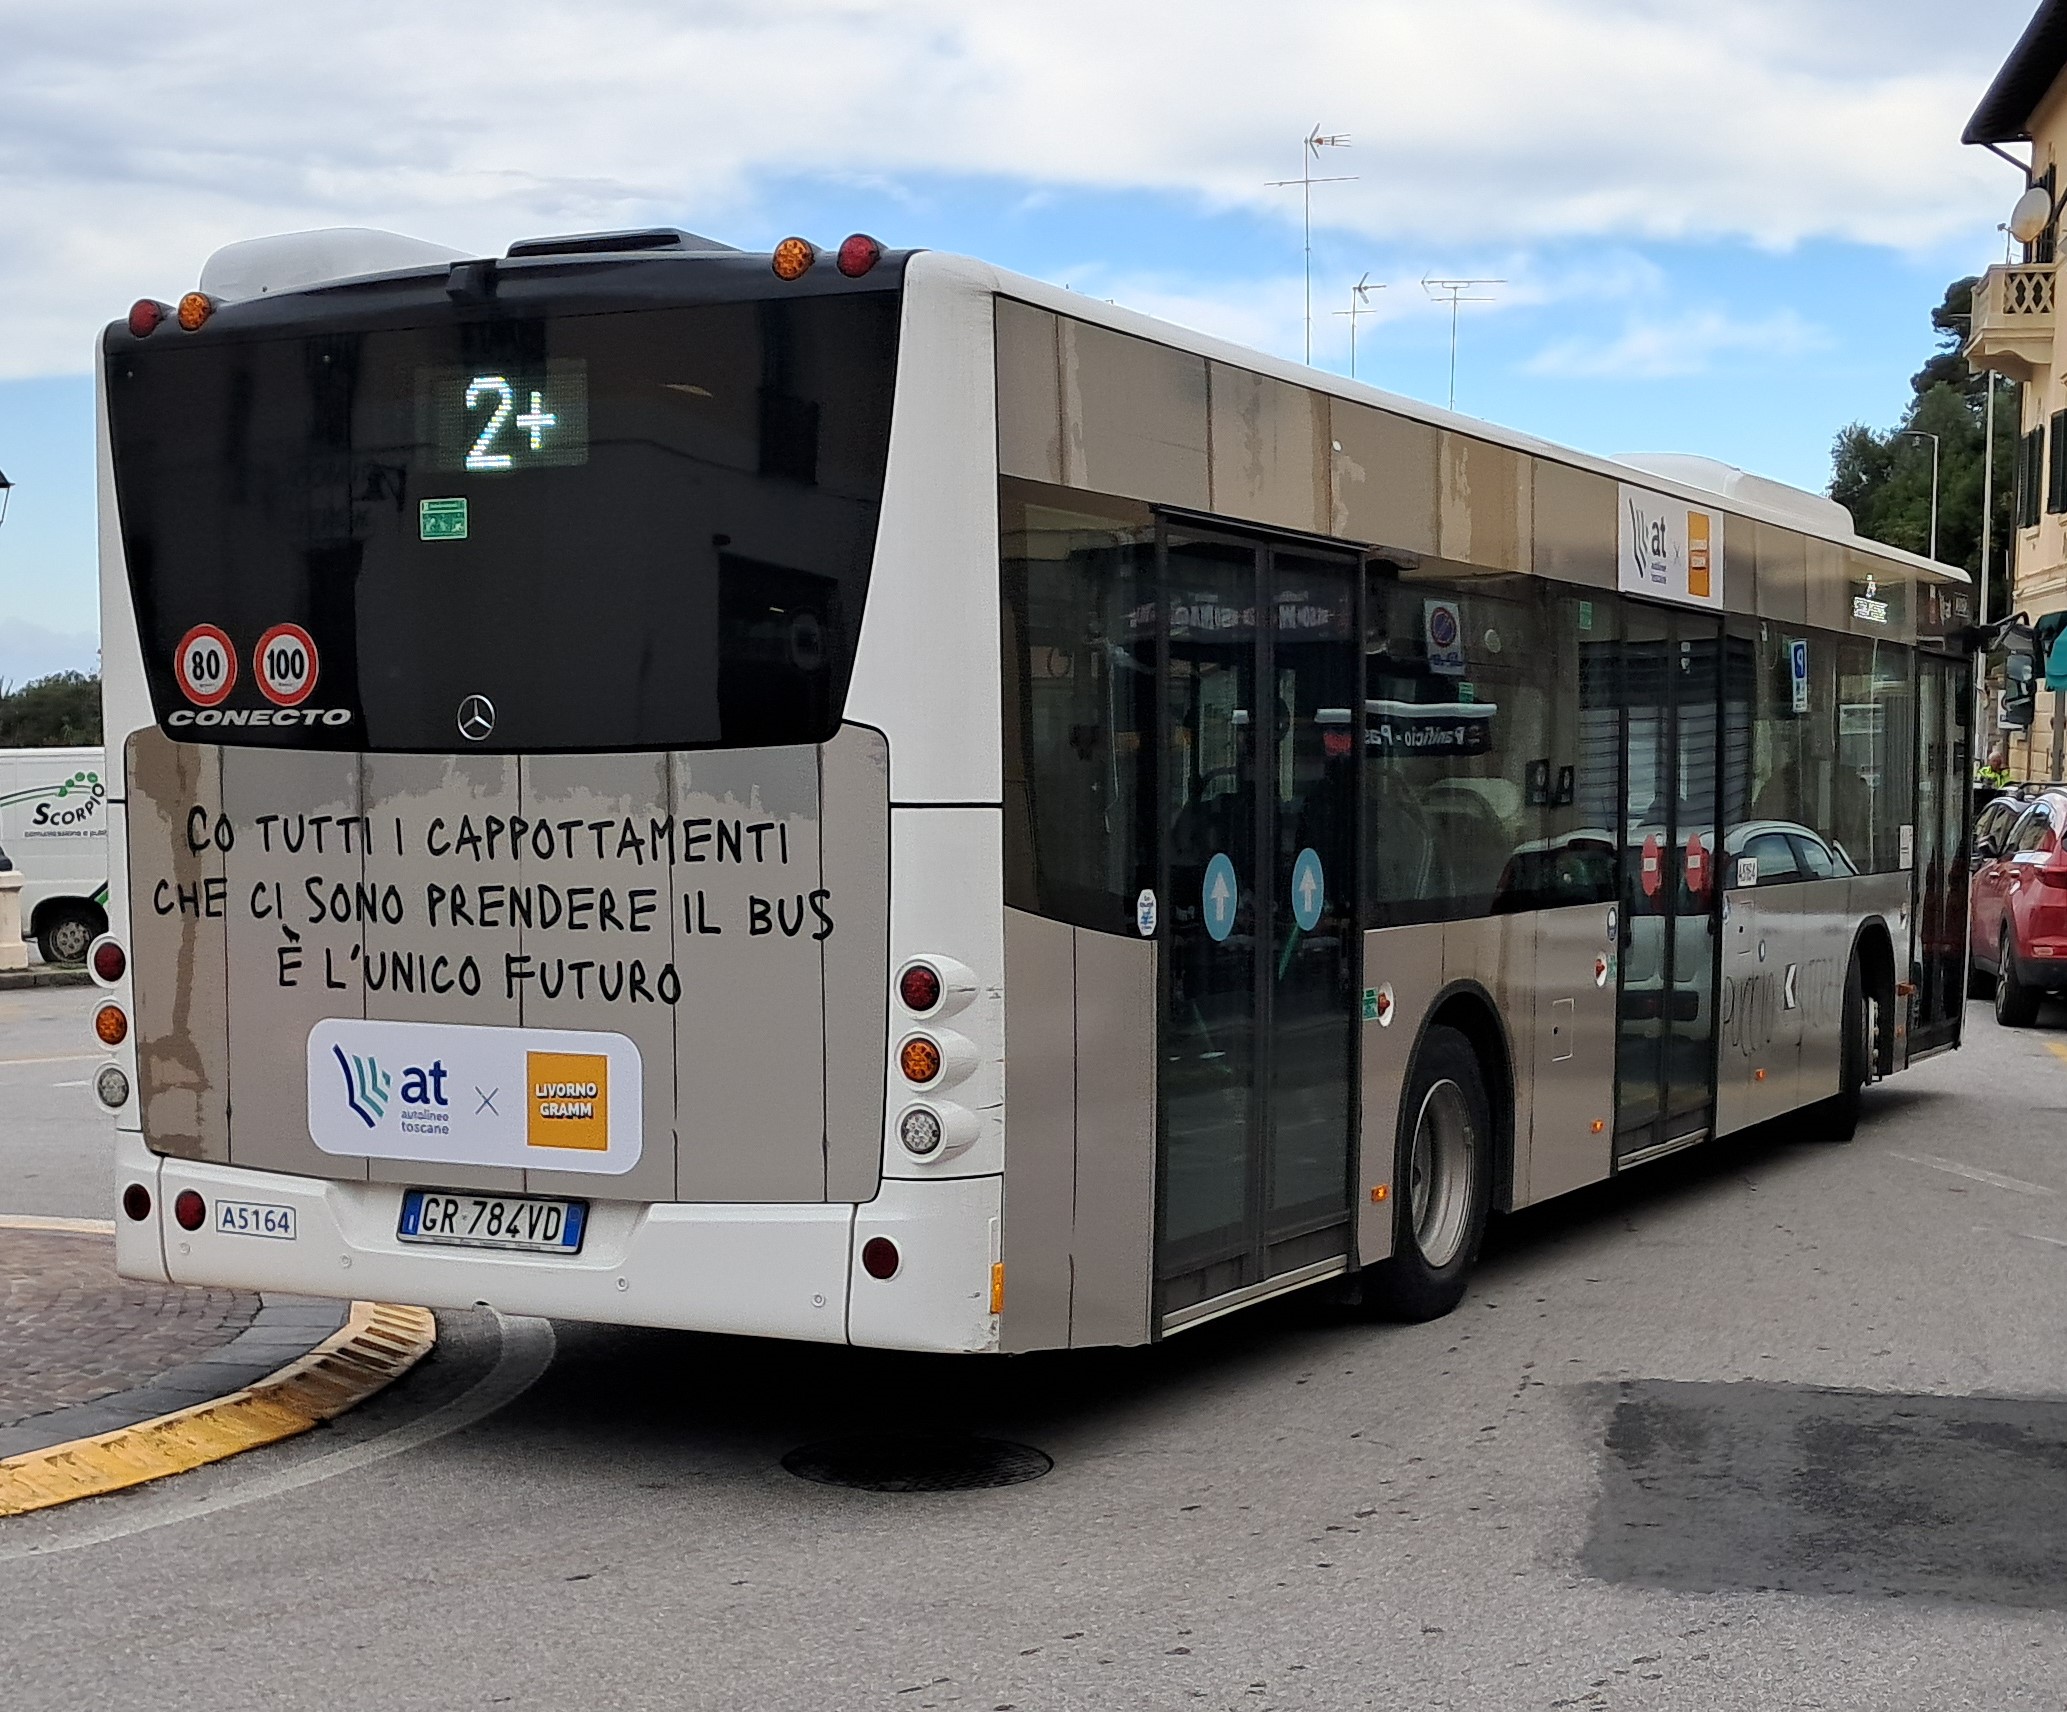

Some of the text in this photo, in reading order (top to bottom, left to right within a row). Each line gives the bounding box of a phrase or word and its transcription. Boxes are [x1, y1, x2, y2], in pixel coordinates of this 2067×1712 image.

[1651, 516, 1666, 558] at
[192, 649, 220, 680] 80
[267, 648, 304, 680] 100
[168, 708, 351, 727] CONECTO
[32, 783, 104, 825] SCORPIO
[187, 805, 788, 866] CO TUTTI I CAPPOTTAMENTI
[153, 876, 835, 941] CHE CI SONO PRENDERE IL BUS
[277, 923, 682, 1005] È L'UNICO FUTURO
[400, 1059, 449, 1106] at
[535, 1082, 598, 1099] LIVORNO
[401, 1121, 449, 1135] toscane
[540, 1102, 594, 1120] GRAMM
[221, 1204, 290, 1234] A5164
[421, 1197, 458, 1236] GR
[467, 1199, 563, 1242] 784VD
